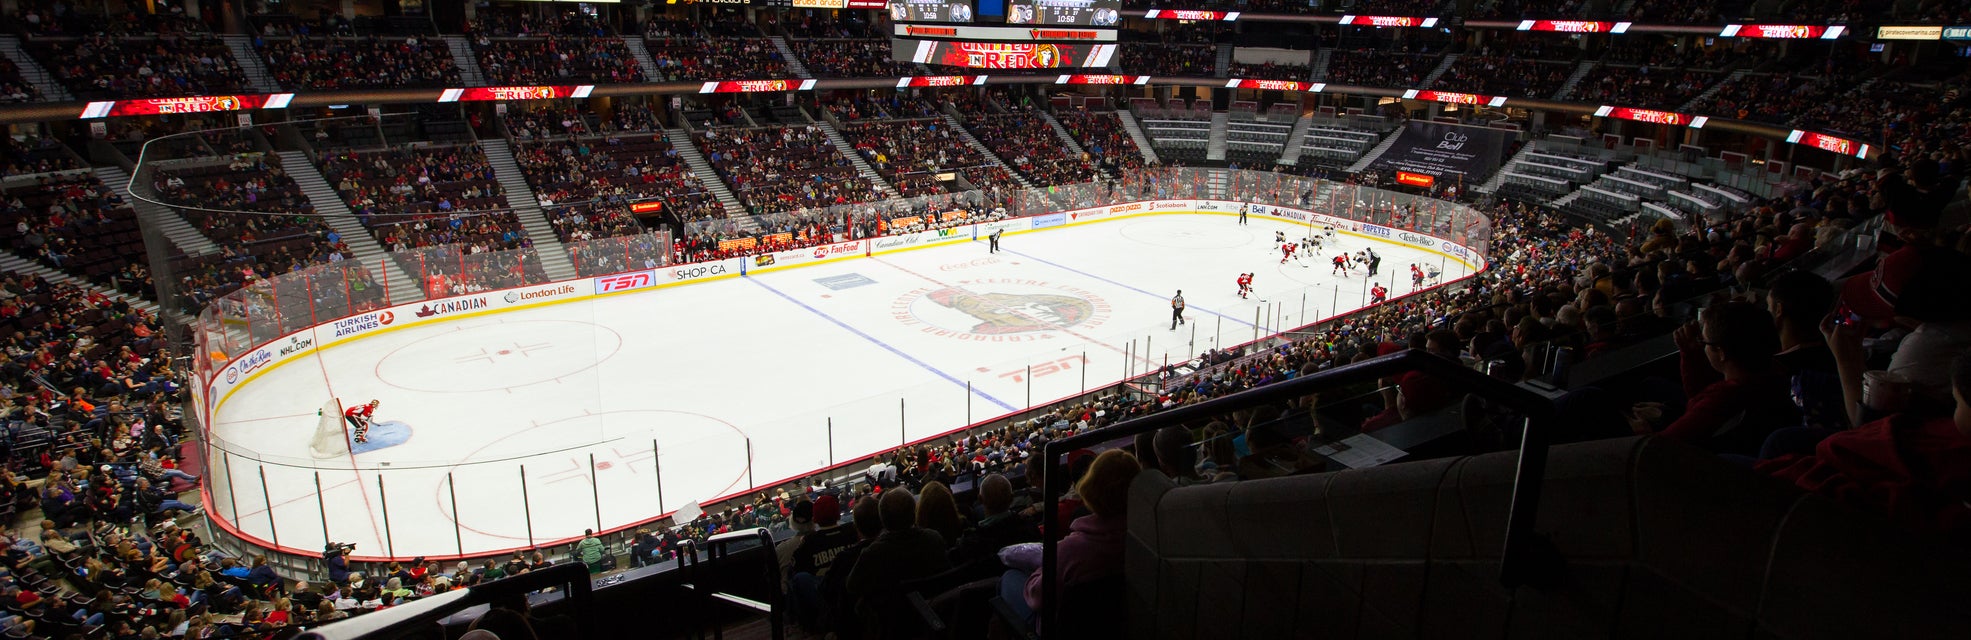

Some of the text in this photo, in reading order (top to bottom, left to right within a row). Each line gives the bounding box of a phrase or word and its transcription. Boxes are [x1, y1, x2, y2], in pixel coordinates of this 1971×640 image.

[1057, 15, 1075, 23] 10:59
[968, 52, 1029, 68] IN RED
[173, 102, 211, 114] RED
[1444, 131, 1468, 142] Club
[1436, 141, 1464, 151] Bell
[1109, 204, 1141, 215] pizza pizza
[1252, 205, 1266, 214] Bell
[1280, 209, 1306, 221] CANADIAN
[938, 227, 958, 237] WM
[601, 274, 649, 291] TSN
[520, 284, 575, 300] London Life
[434, 297, 487, 315] CANADIAN
[335, 313, 377, 330] TURKISH
[336, 320, 379, 337] AIRLINES
[280, 338, 312, 357] NHL.COM
[998, 355, 1091, 383] TSN
